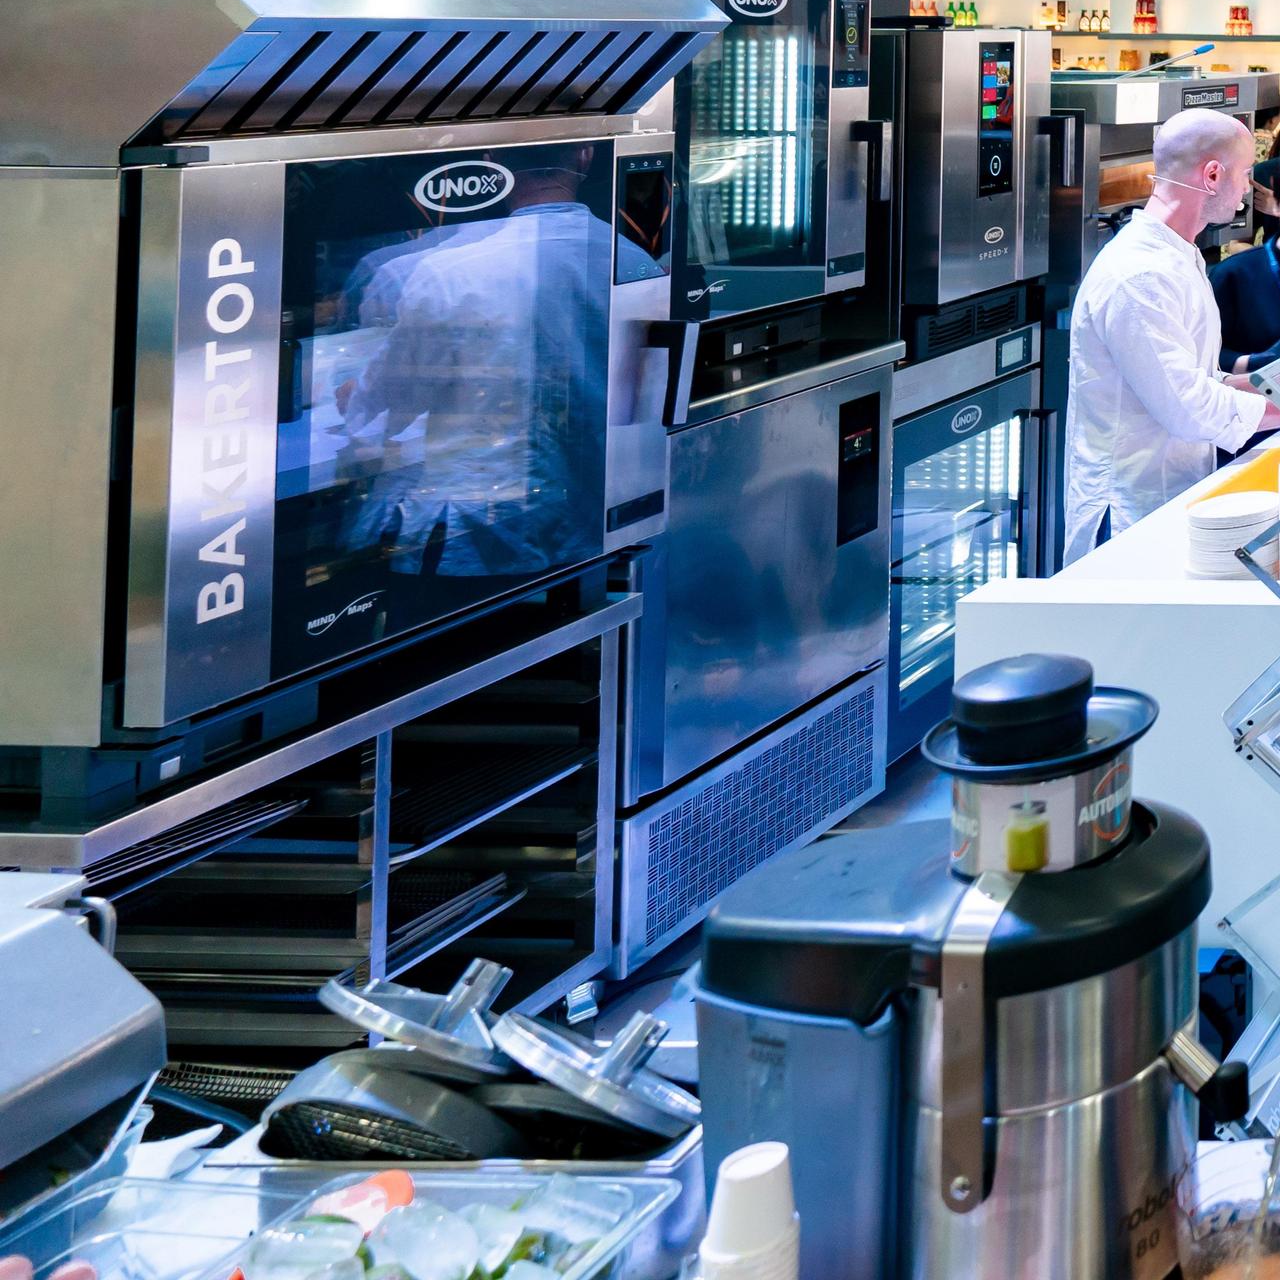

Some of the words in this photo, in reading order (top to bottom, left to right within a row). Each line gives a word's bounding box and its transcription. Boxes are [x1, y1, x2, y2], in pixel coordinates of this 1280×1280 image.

[427, 173, 499, 200] UNOX
[198, 238, 256, 624] BAKERTOP
[955, 411, 978, 428] UNOX
[307, 611, 336, 631] MIND
[347, 599, 374, 616] Maps
